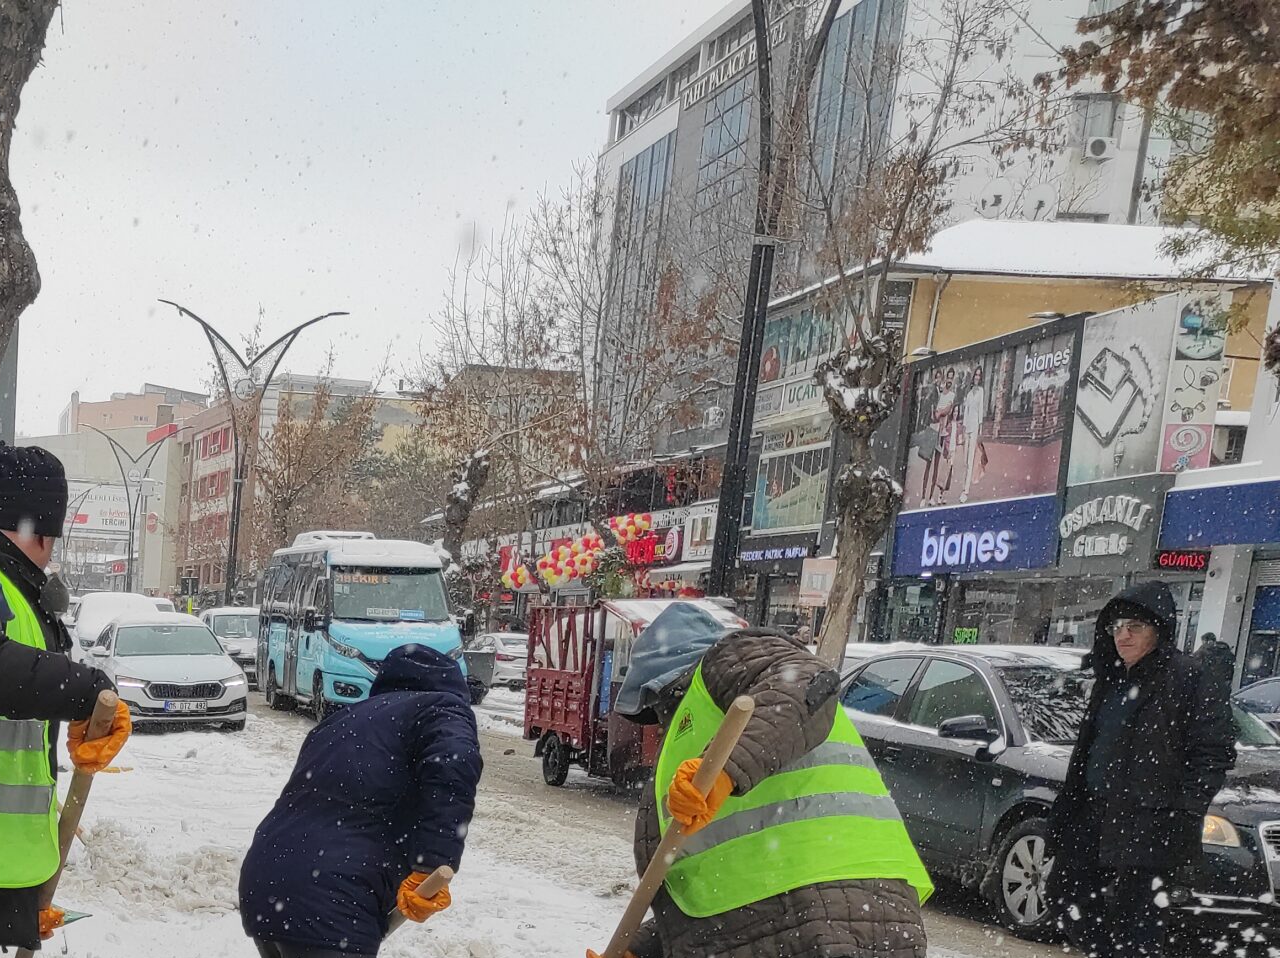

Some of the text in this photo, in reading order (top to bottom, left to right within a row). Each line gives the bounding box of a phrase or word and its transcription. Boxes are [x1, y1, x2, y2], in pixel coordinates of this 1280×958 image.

[708, 48, 747, 92] PALACE
[1023, 349, 1070, 375] bianes
[1060, 495, 1152, 539] OSMANLI
[920, 525, 1011, 567] bianes
